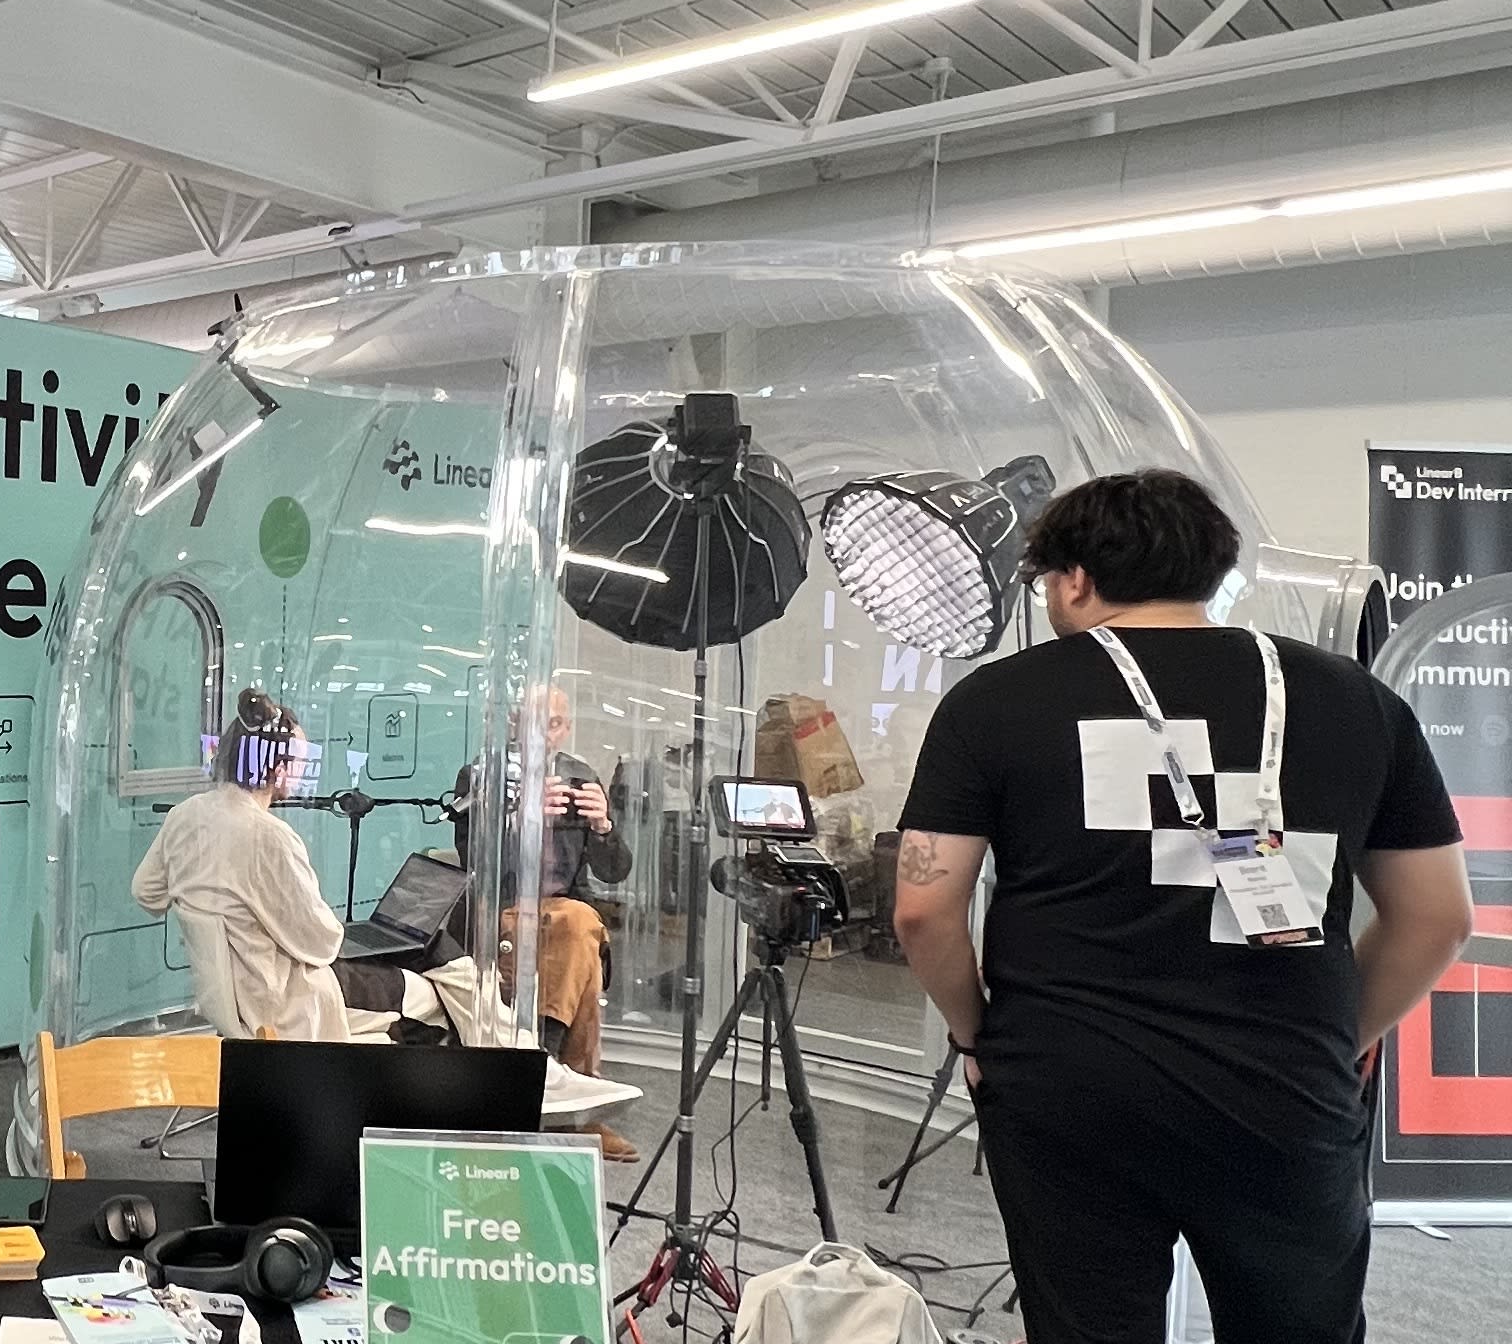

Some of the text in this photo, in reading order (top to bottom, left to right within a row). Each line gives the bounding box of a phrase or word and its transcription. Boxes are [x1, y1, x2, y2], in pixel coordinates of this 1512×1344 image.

[433, 453, 492, 488] Linea
[1416, 482, 1512, 501] Dev Interr
[1388, 572, 1444, 601] Join
[1430, 724, 1464, 736] now
[465, 1164, 520, 1181] LinearB
[443, 1208, 521, 1242] Free
[371, 1246, 596, 1286] Affirmations
